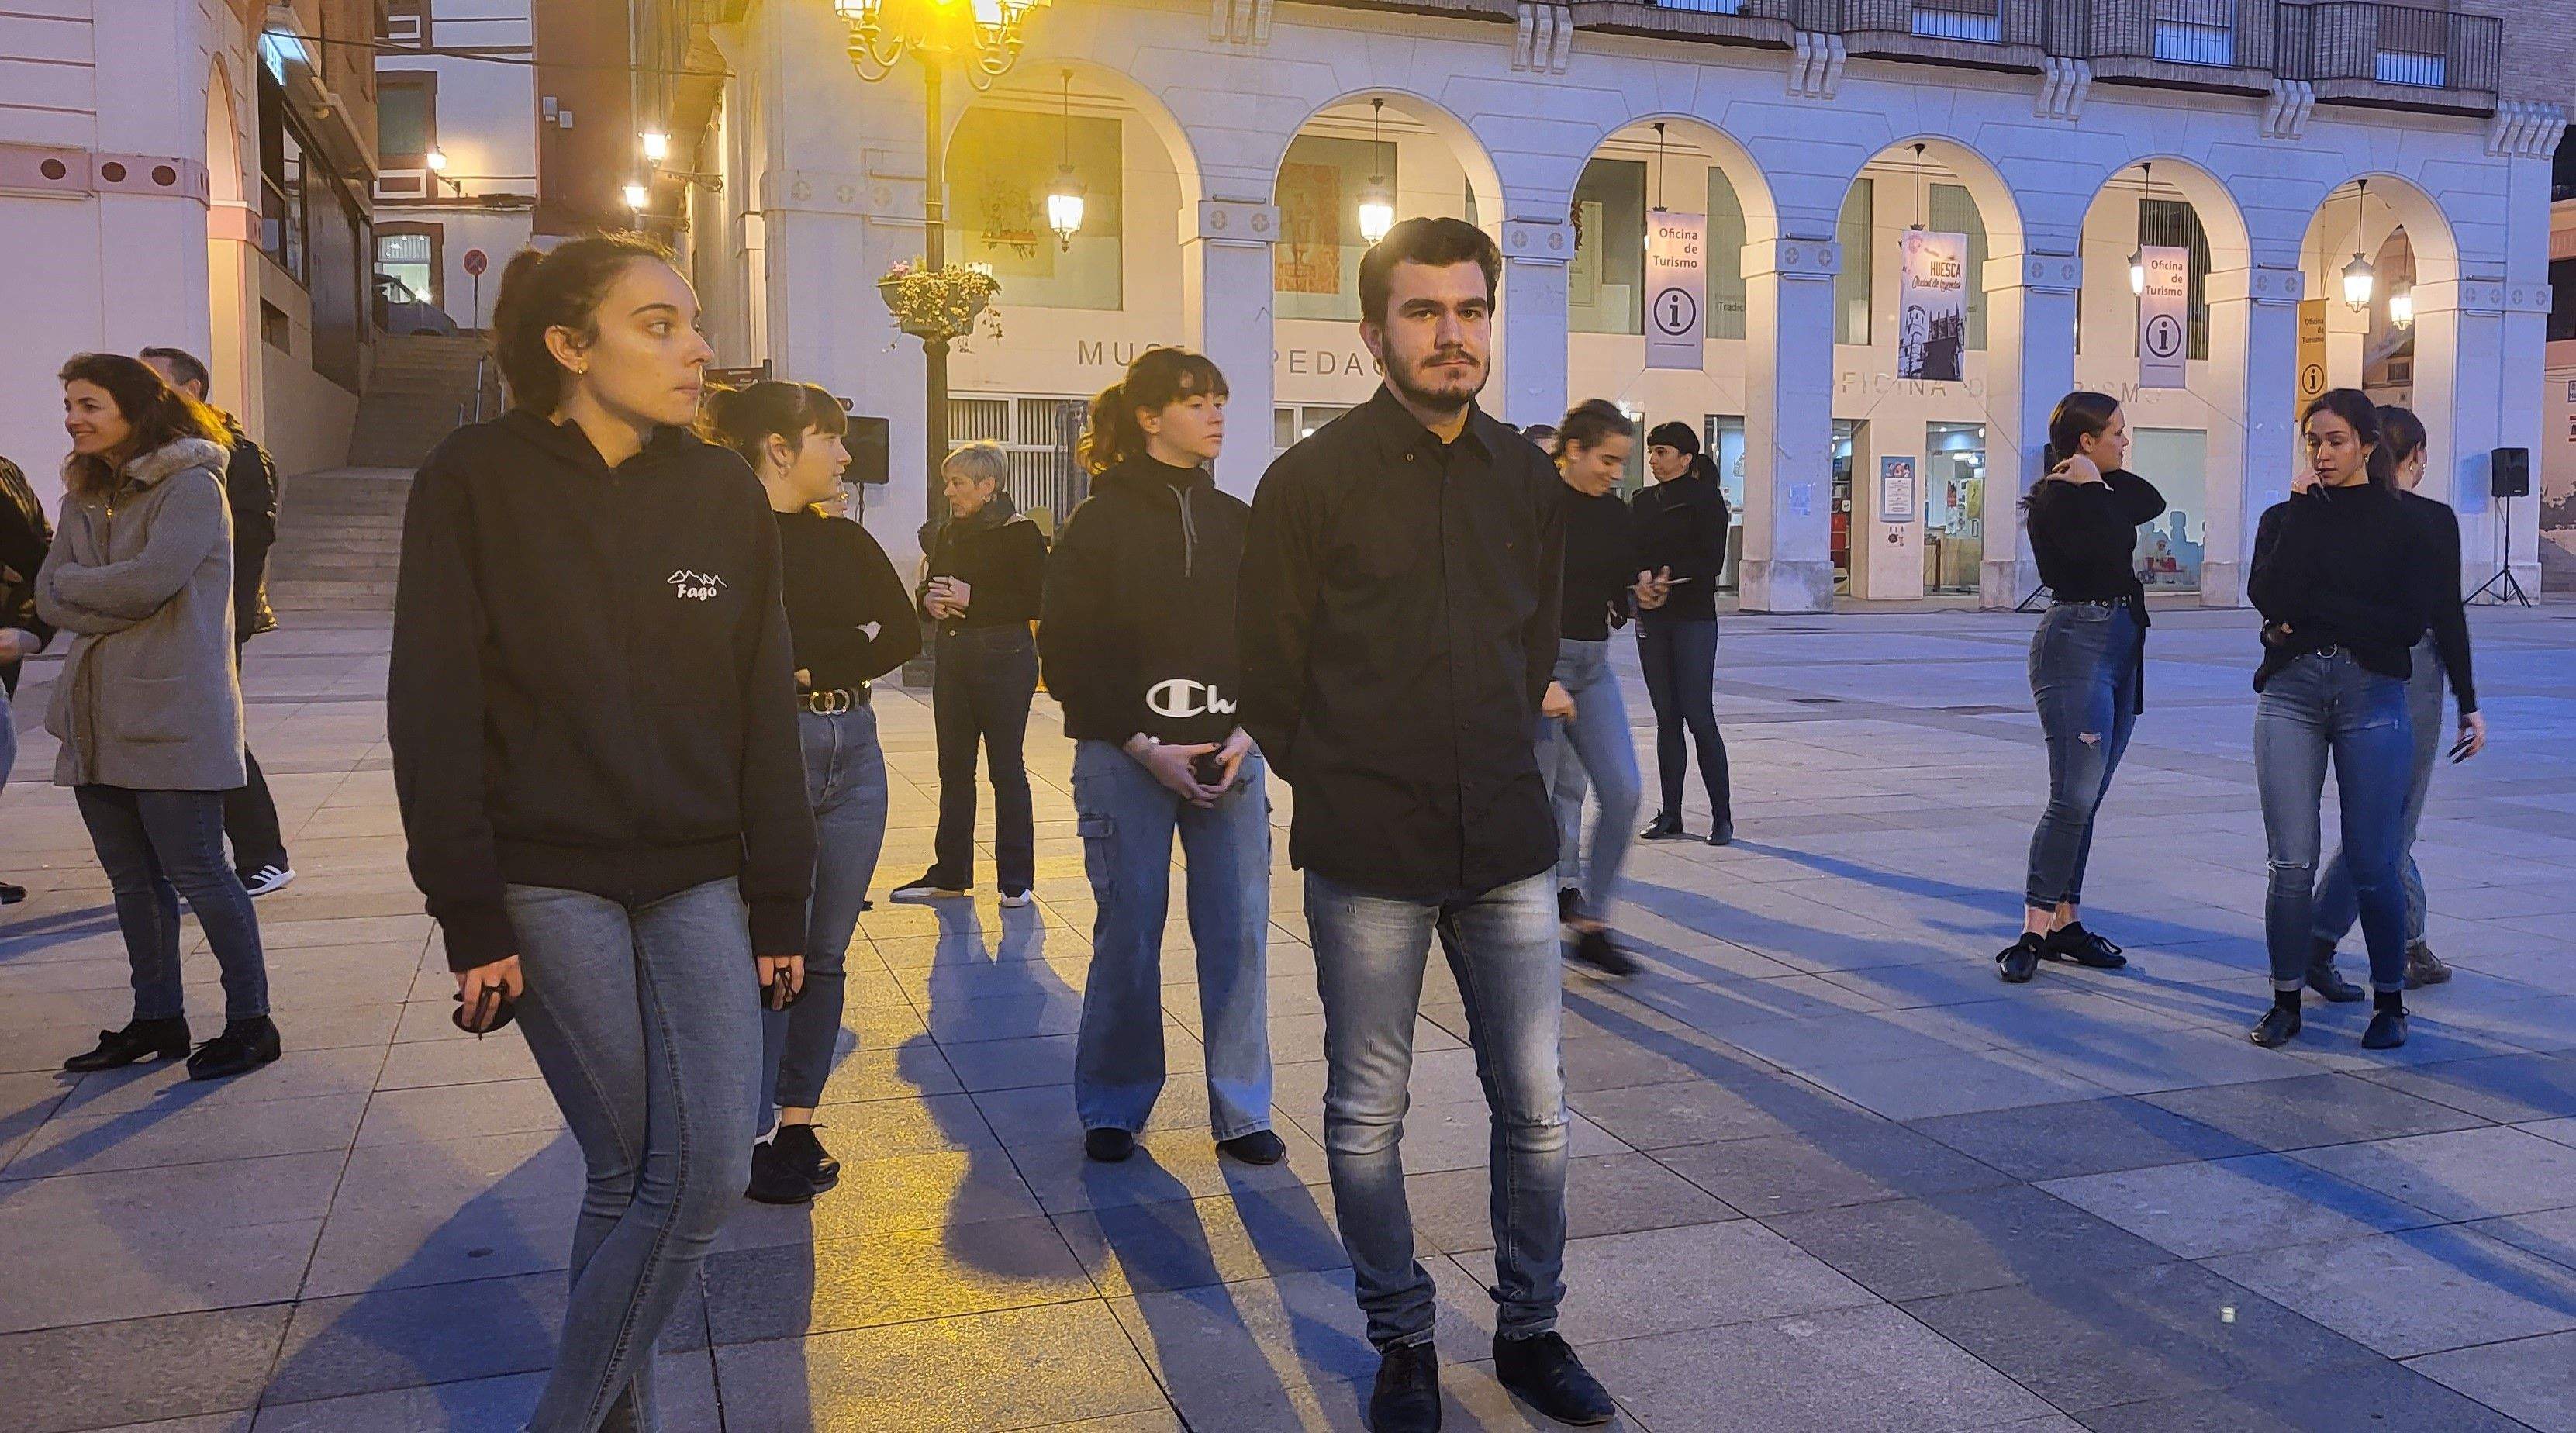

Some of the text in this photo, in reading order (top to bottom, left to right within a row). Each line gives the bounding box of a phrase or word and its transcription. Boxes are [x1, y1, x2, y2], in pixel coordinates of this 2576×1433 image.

[1659, 227, 1698, 240] Oficina
[1683, 242, 1698, 254] de
[1652, 255, 1697, 268] Turismo
[2151, 259, 2183, 271] Oficina
[1930, 261, 1961, 279] HUESCA
[2171, 273, 2183, 284] de
[2146, 285, 2183, 296] Turismo
[677, 583, 717, 602] Fago
